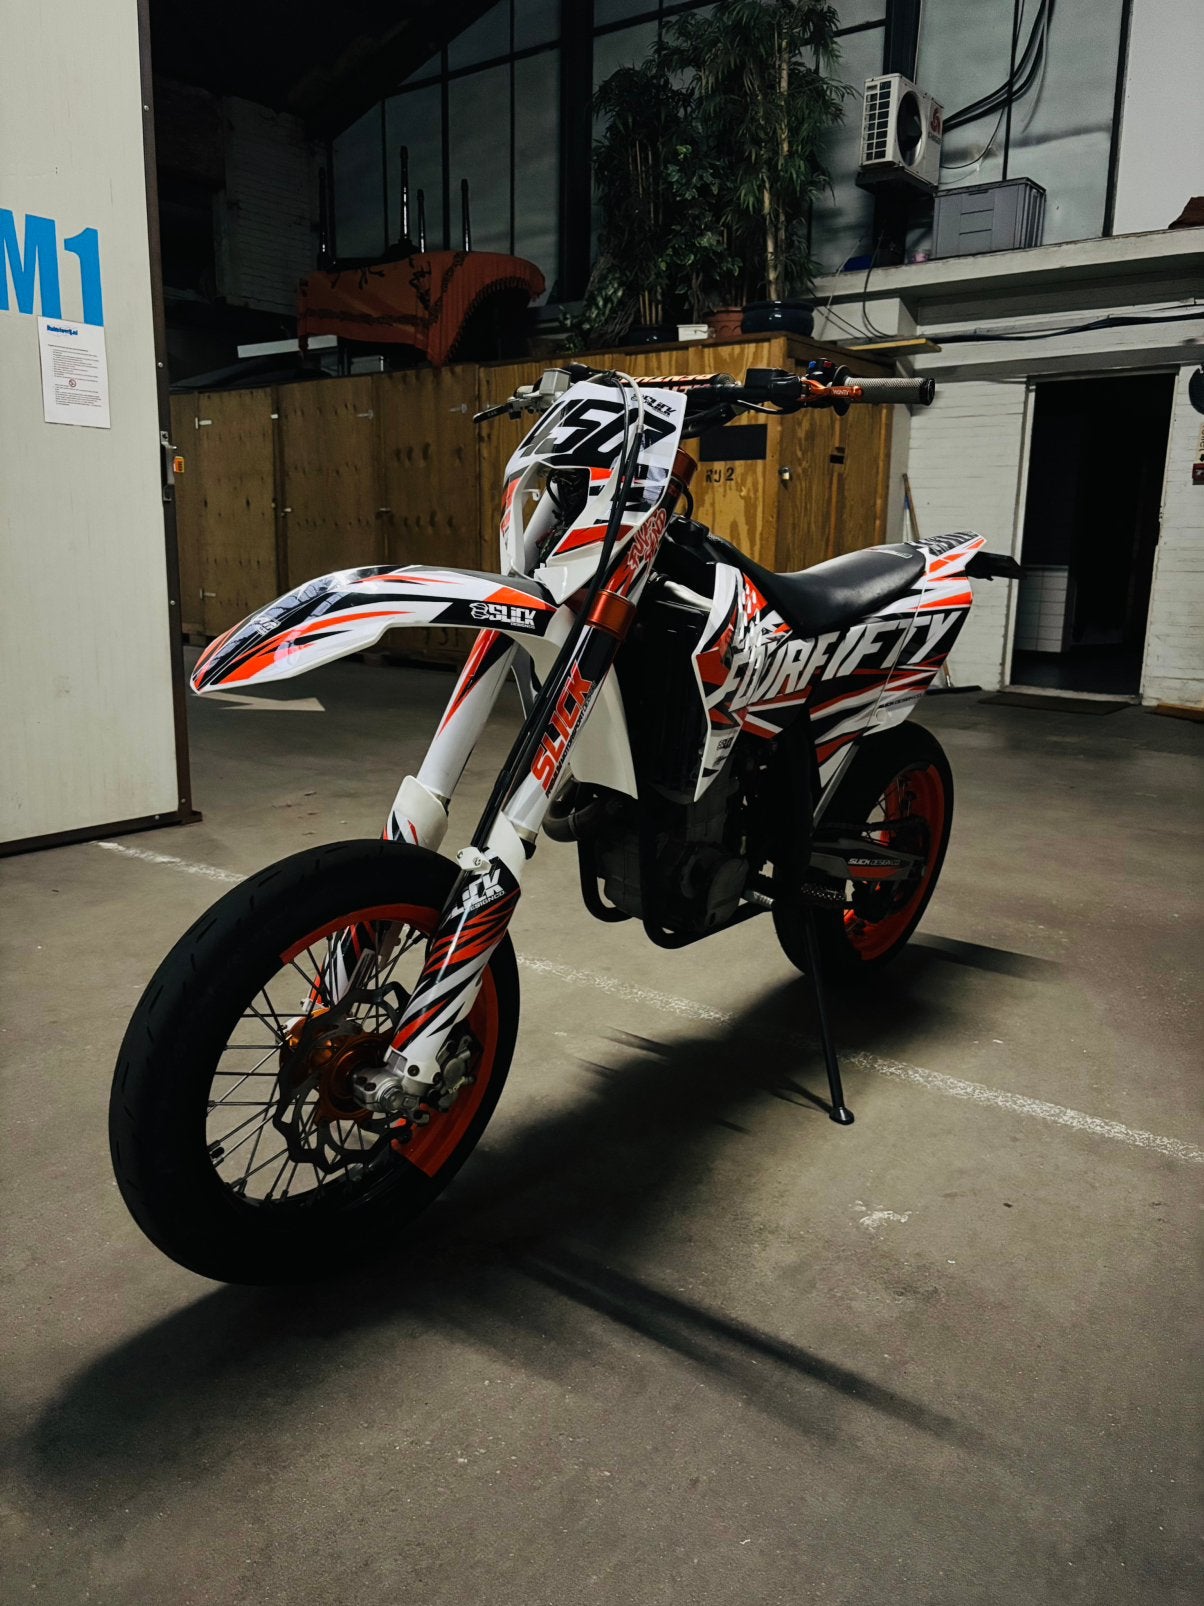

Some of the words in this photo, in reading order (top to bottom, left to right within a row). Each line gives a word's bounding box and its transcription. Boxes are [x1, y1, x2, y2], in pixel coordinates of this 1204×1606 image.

[725, 467, 735, 481] 2
[487, 603, 537, 626] SLICK
[530, 659, 593, 792] SLICK
